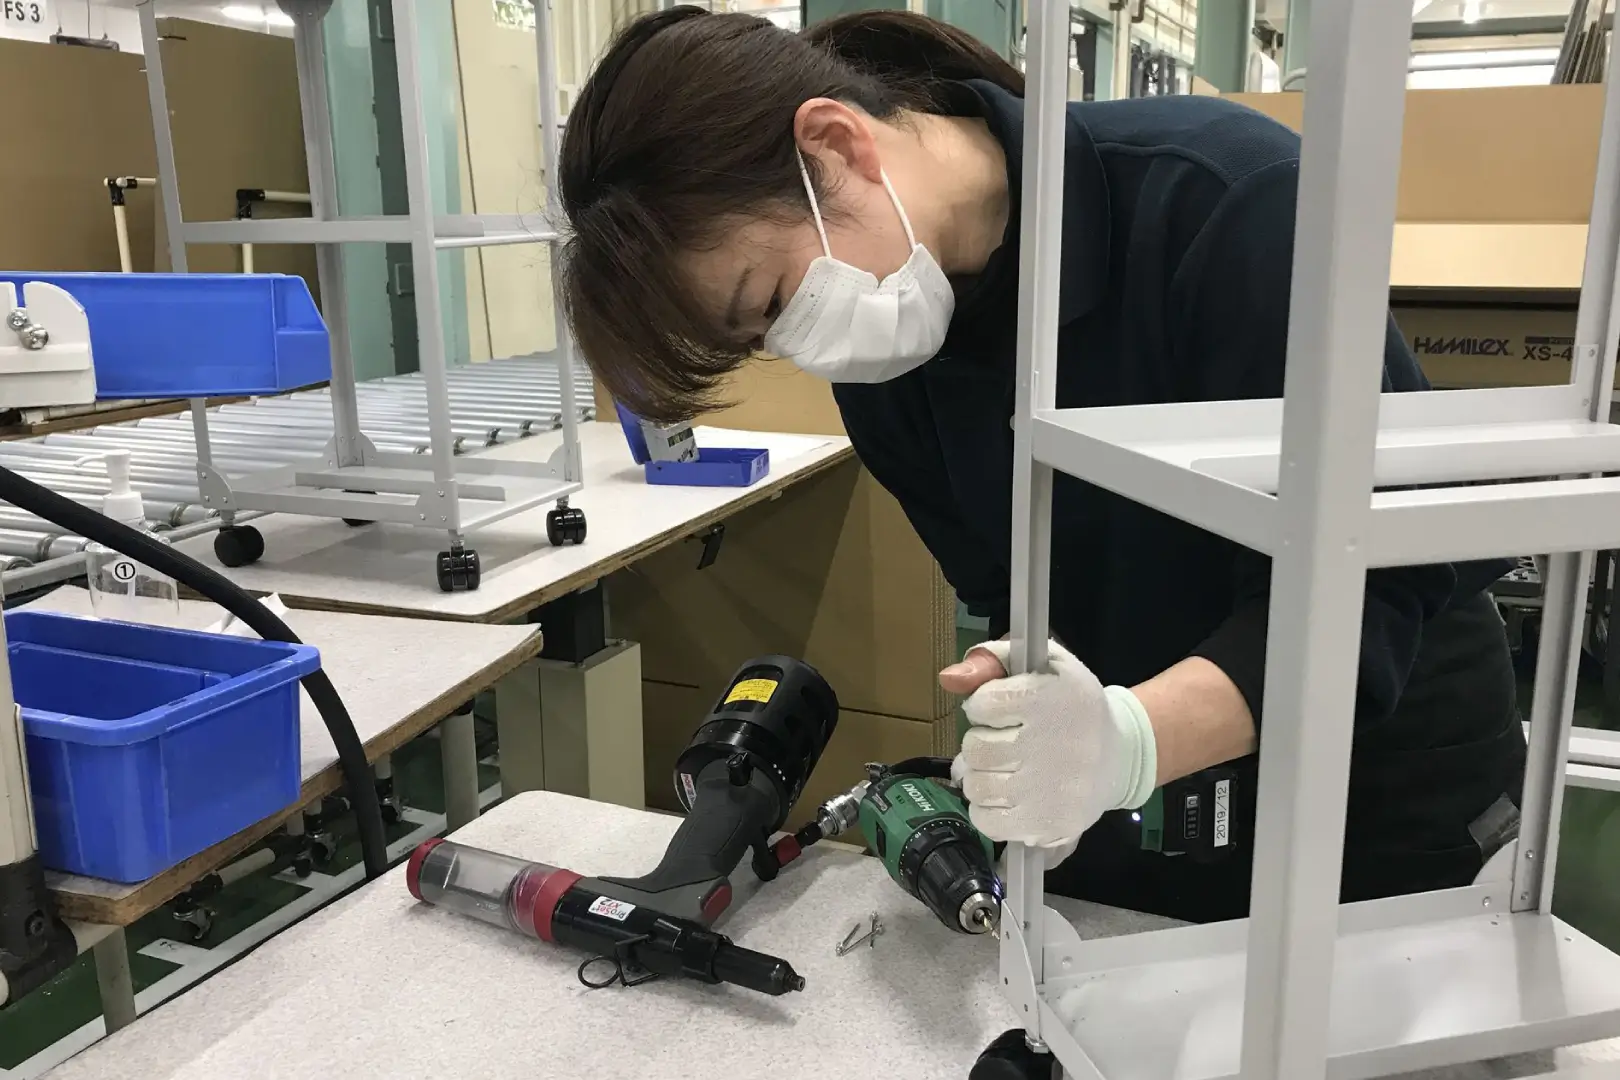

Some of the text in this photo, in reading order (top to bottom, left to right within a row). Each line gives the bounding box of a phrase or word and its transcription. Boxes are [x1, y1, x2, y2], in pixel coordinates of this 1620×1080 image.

[4, 1, 40, 23] FS 3
[1413, 336, 1509, 356] HAMILEX
[1216, 786, 1227, 839] 2019/12
